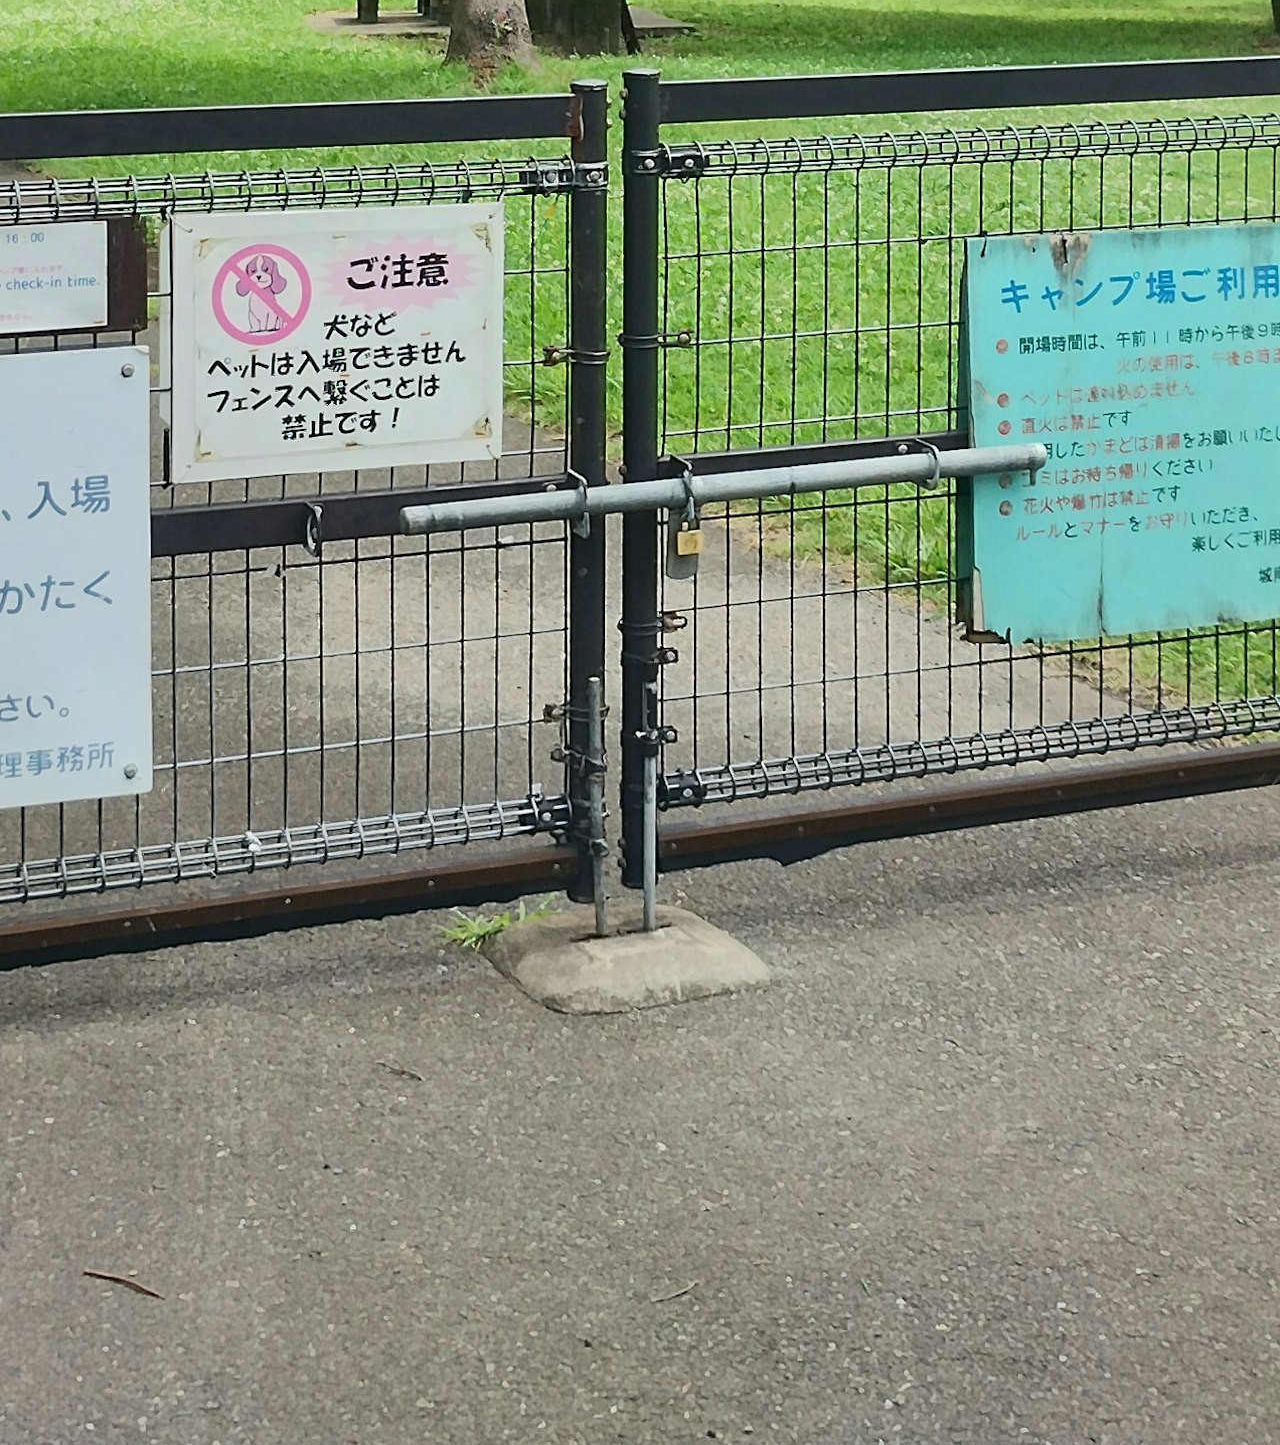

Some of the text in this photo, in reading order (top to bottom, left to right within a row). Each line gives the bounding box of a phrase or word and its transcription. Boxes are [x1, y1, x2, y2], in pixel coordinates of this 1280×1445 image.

[6, 275, 62, 291] check-in
[346, 252, 449, 290] ご注意
[323, 312, 398, 341] 犬など
[206, 340, 467, 379] ペットは入場できません
[206, 374, 442, 413] フェンスへ繋ぐことは
